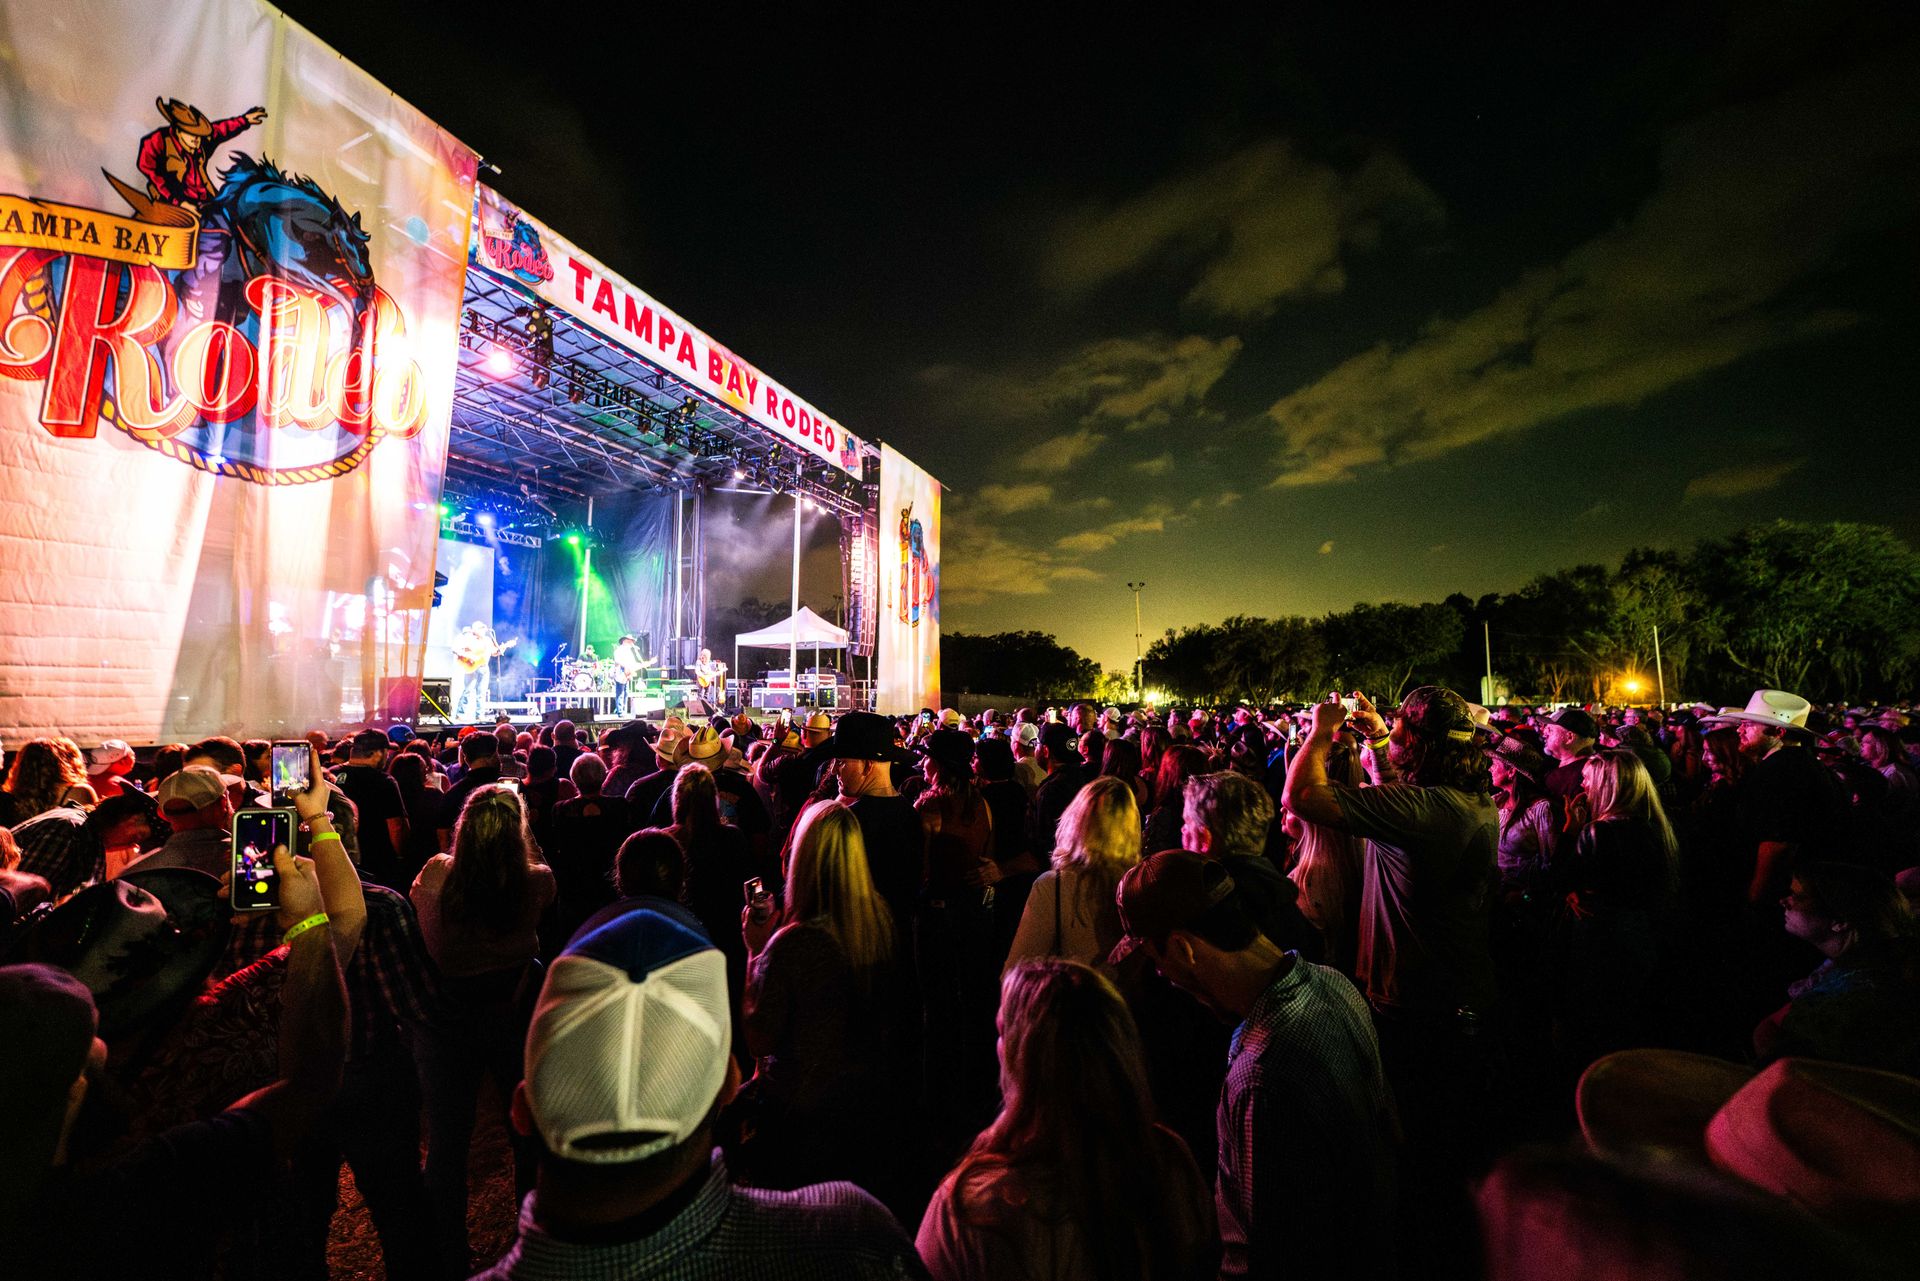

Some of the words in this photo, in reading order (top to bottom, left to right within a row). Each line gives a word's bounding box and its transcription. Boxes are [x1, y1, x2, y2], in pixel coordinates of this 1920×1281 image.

[0, 208, 101, 245] AMPA
[113, 226, 170, 257] BAY
[485, 237, 555, 281] Rodeo
[0, 247, 428, 439] Rodeo
[568, 257, 698, 371] TAMPA
[709, 345, 758, 406] BAY
[766, 388, 835, 453] RODEO
